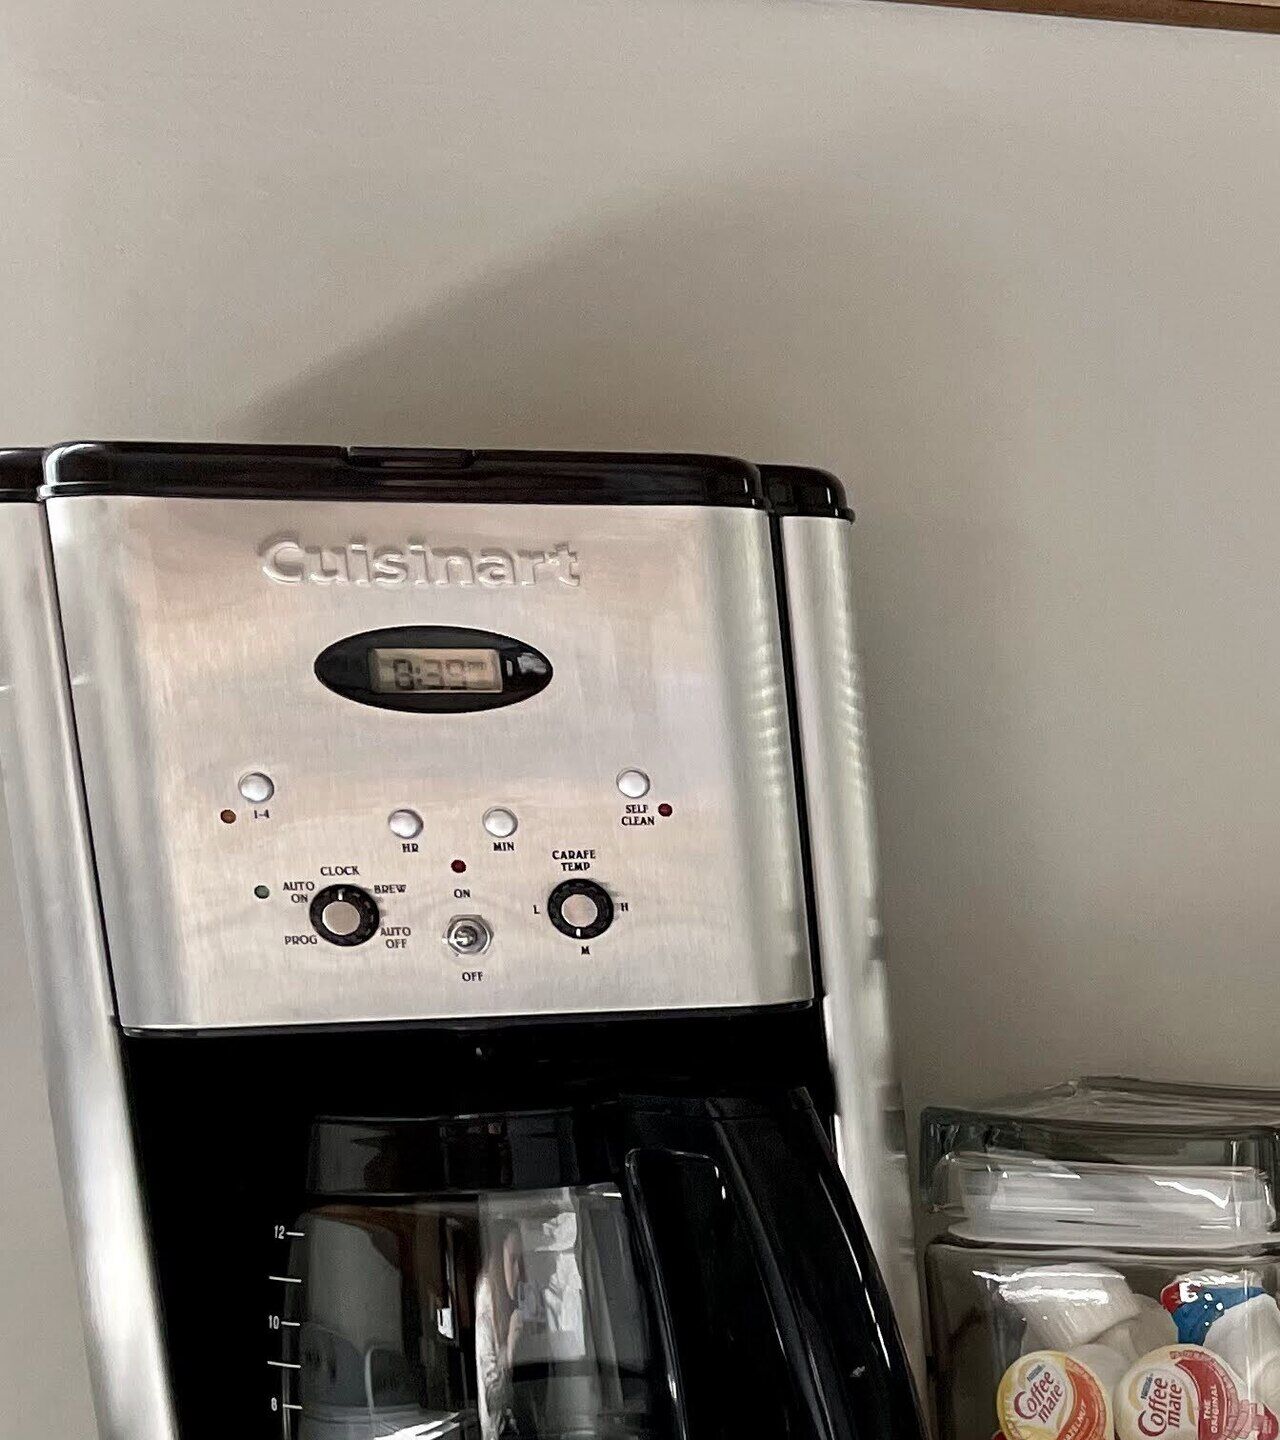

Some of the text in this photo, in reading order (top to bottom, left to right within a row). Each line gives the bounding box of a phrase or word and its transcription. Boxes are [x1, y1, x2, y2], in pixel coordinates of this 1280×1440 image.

[257, 534, 581, 586] Cuisinart
[253, 809, 271, 820] 1-4
[625, 804, 650, 815] SELF
[621, 815, 656, 826] CLEAN
[401, 843, 420, 853] HR
[493, 841, 516, 852] MIN
[551, 849, 597, 860] CARAFE
[319, 865, 361, 876] CLOCK
[560, 861, 591, 872] TEMP
[282, 881, 316, 892] AUTO
[373, 884, 408, 895] BREW
[290, 893, 309, 904] ON
[453, 888, 472, 899] ON
[532, 904, 541, 915] L
[620, 902, 630, 912] H
[379, 926, 413, 937] AUTO
[283, 934, 319, 946] PROG
[385, 938, 408, 949] OFF
[580, 945, 591, 955] M
[461, 971, 485, 982] OFF
[273, 1224, 286, 1240] 12
[268, 1314, 280, 1330] 10
[1013, 1371, 1055, 1420] Coffee
[1038, 1384, 1064, 1424] mate
[1138, 1377, 1169, 1437] Coffee
[1167, 1383, 1183, 1428] mate
[1210, 1384, 1219, 1434] ORIGINAL
